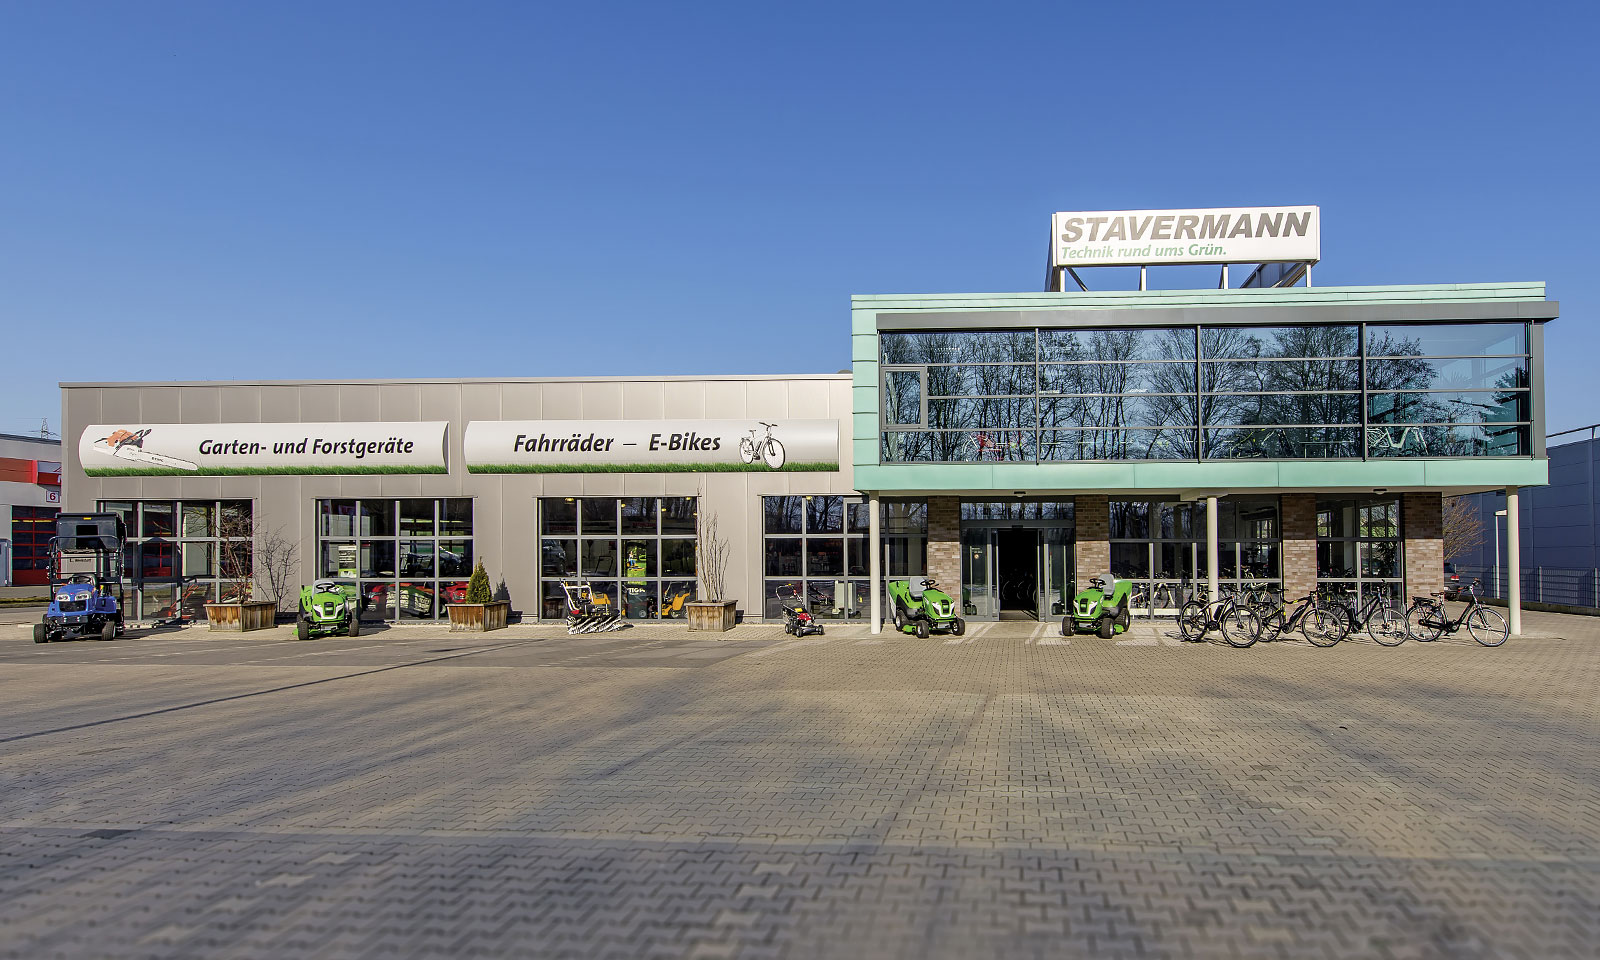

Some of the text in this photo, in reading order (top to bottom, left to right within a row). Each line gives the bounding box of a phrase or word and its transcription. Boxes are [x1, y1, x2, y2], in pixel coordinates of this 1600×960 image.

[1061, 211, 1312, 243] STAVERMANN
[1061, 243, 1227, 260] Technik rund ums Grün.
[199, 437, 414, 459] Garten- und Forstgeräte
[513, 433, 615, 452] Fahrräder
[648, 432, 721, 451] E-Bikes
[49, 493, 56, 501] 6
